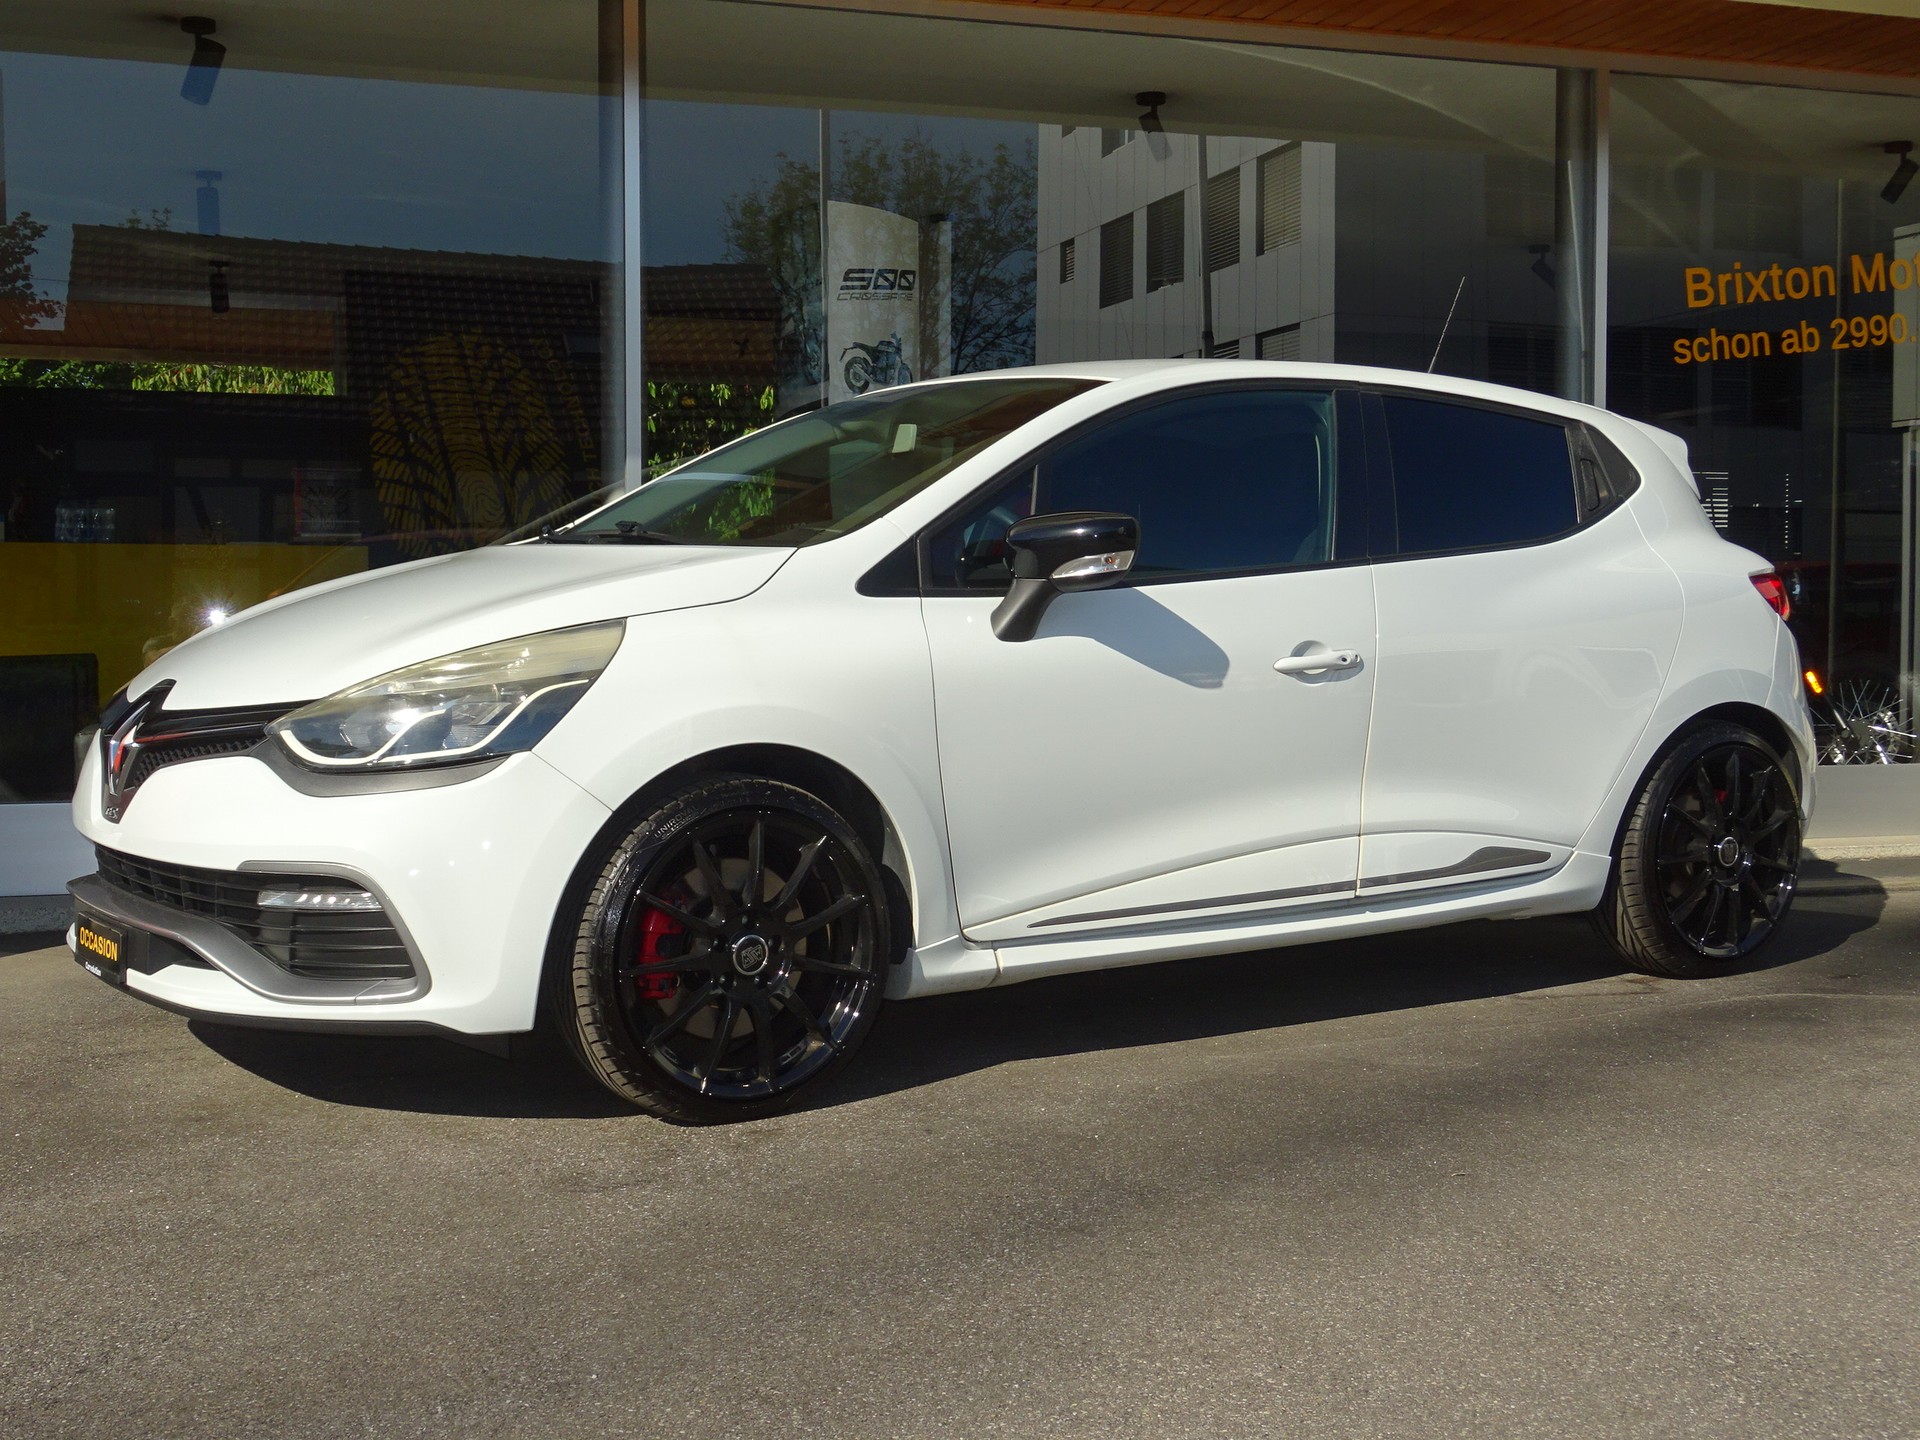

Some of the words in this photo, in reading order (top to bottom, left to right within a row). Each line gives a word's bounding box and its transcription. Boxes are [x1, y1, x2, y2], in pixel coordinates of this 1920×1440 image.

[1685, 262, 1836, 308] Brixton
[1673, 328, 1771, 365] schon
[1781, 320, 1820, 354] ab
[654, 805, 700, 838] UNIROYAL
[80, 927, 117, 961] OCCASION
